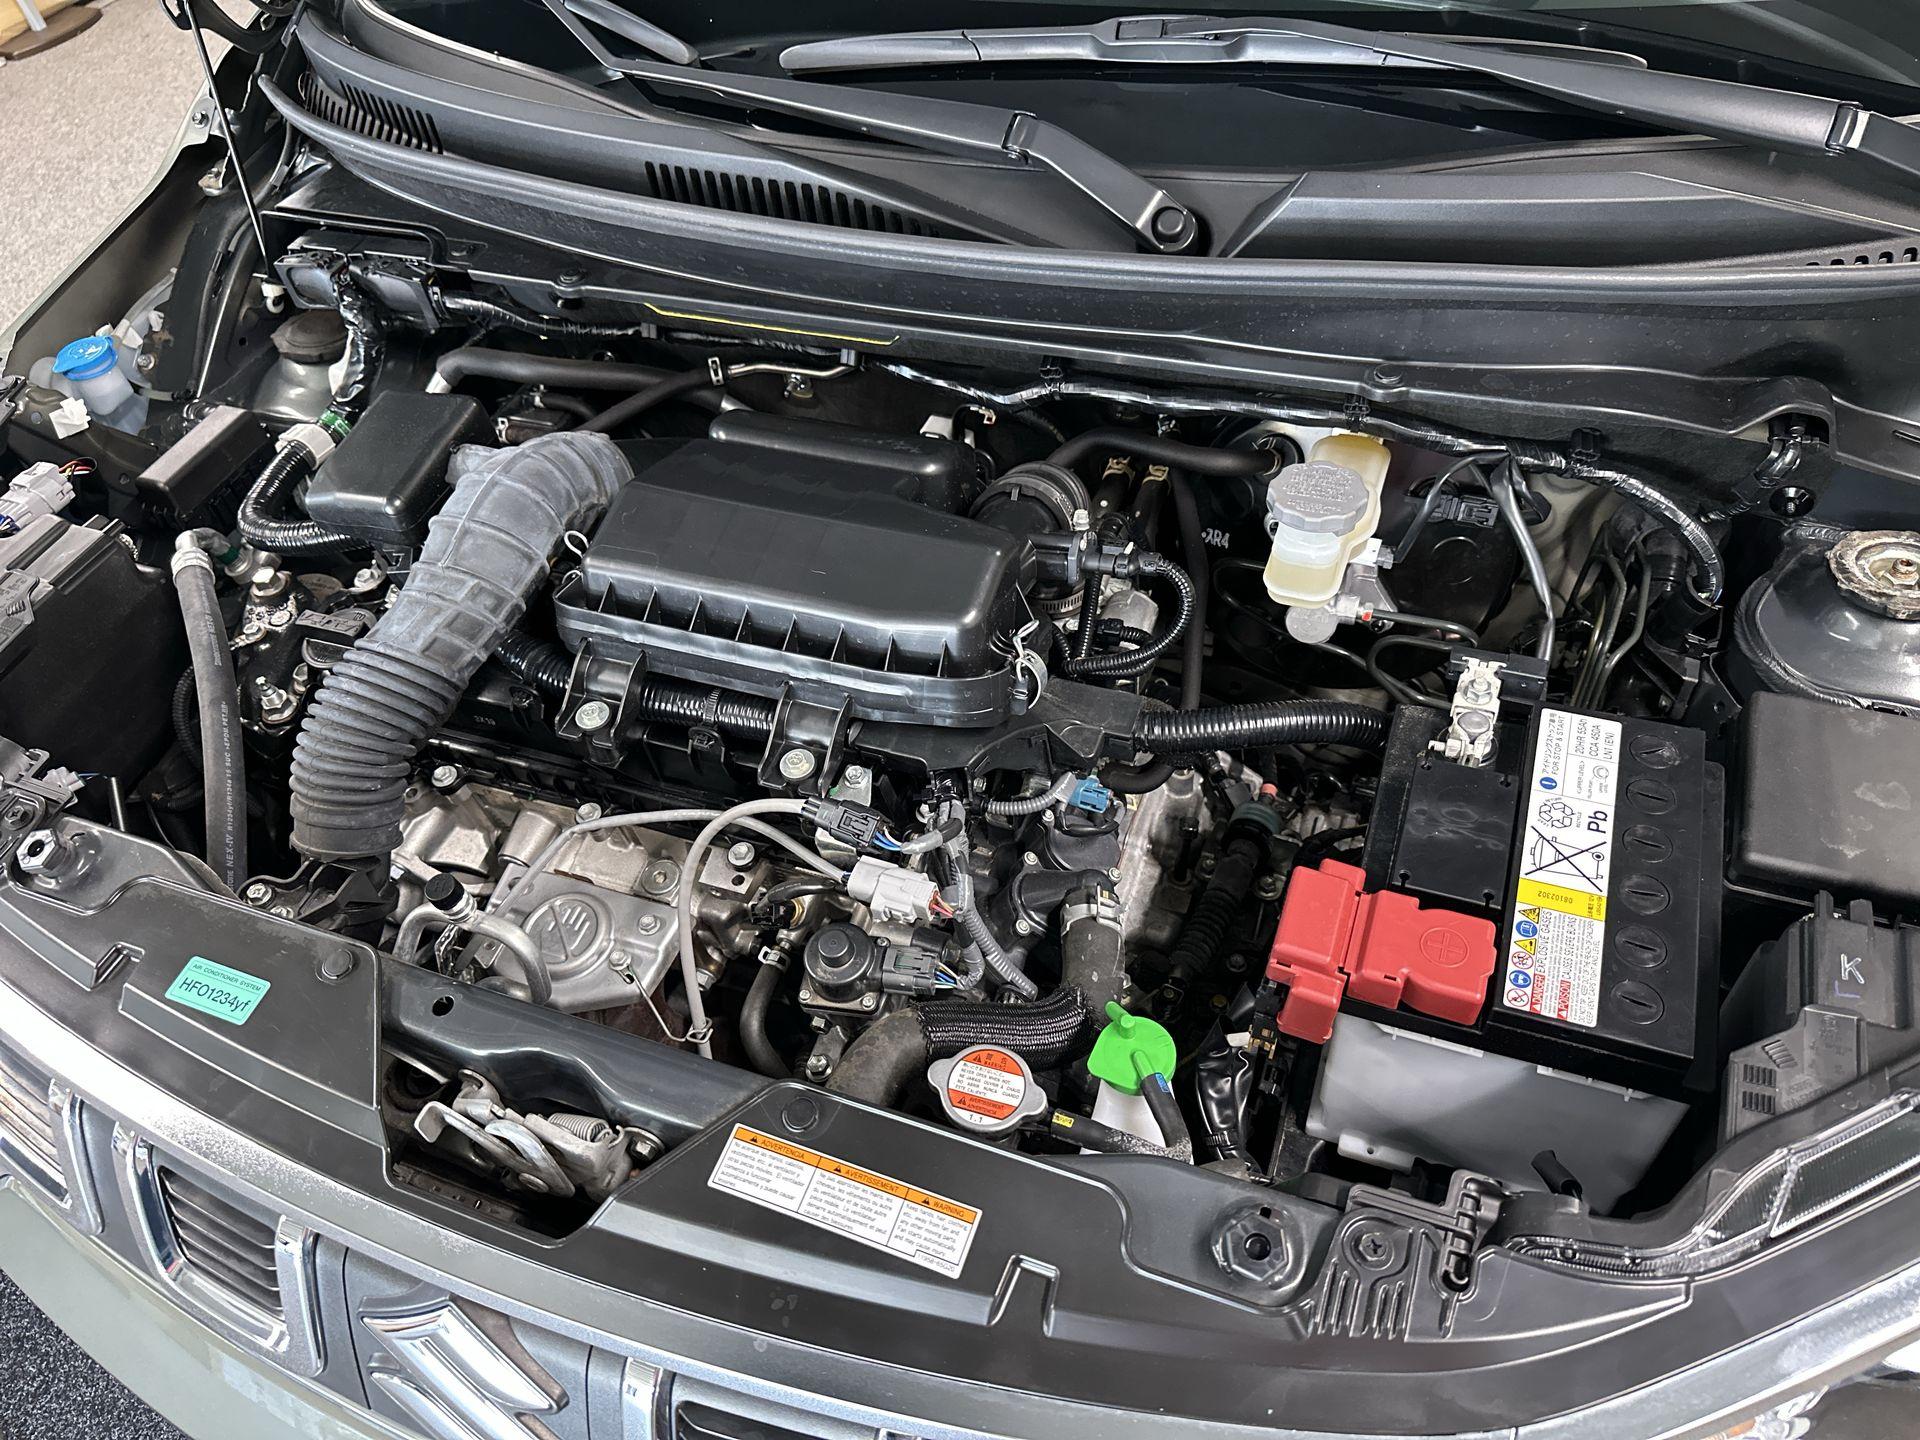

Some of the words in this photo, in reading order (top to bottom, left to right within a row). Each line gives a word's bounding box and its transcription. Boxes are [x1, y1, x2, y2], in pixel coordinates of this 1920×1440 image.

[1556, 715, 1564, 735] START
[1552, 742, 1561, 760] STOP
[1574, 735, 1585, 754] 20HR
[1551, 760, 1559, 775] FOR
[1587, 810, 1607, 833] Pb
[1540, 910, 1552, 933] GASES
[1566, 916, 1577, 935] BURNS
[1535, 935, 1549, 973] EXPLOSIVE
[1563, 935, 1575, 956] SEVERE
[203, 967, 238, 982] CONDITIONER
[1561, 957, 1572, 979] CAUSES
[1840, 953, 1865, 984] K
[179, 978, 250, 1011] HFO1234yf
[1532, 975, 1544, 1003] DANGER
[1558, 981, 1570, 1009] POISON
[969, 1113, 982, 1122] 1.1
[761, 1139, 804, 1158] ADVERTENCIA
[845, 1169, 898, 1191] AVERTISSEMENT
[933, 1201, 963, 1217] WARNING
